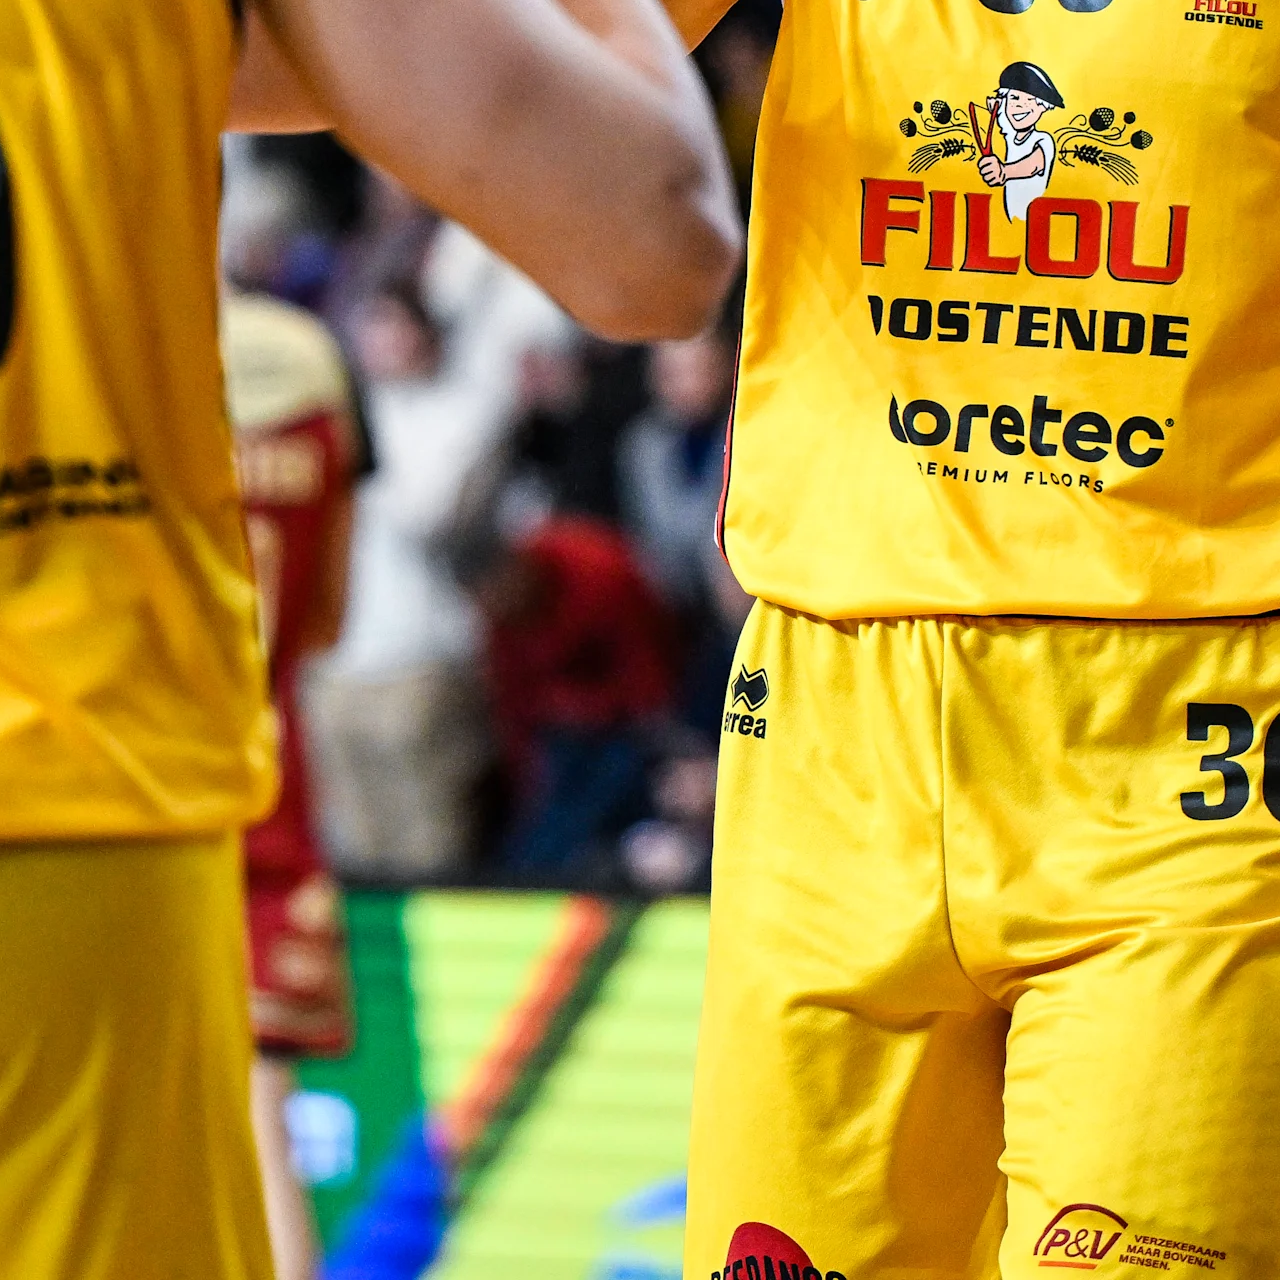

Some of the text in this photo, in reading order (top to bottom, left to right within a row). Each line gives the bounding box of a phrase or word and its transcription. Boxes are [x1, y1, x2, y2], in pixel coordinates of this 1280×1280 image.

[1184, 12, 1263, 30] OOSTENDE
[860, 177, 1190, 285] FILOU
[1023, 471, 1104, 493] FLOORS
[1042, 1228, 1123, 1260] P&V
[1126, 1244, 1217, 1271] MAAR BOVENAL
[1134, 1234, 1227, 1261] VERZEKERAARS
[1118, 1254, 1171, 1271] MENSEN.
